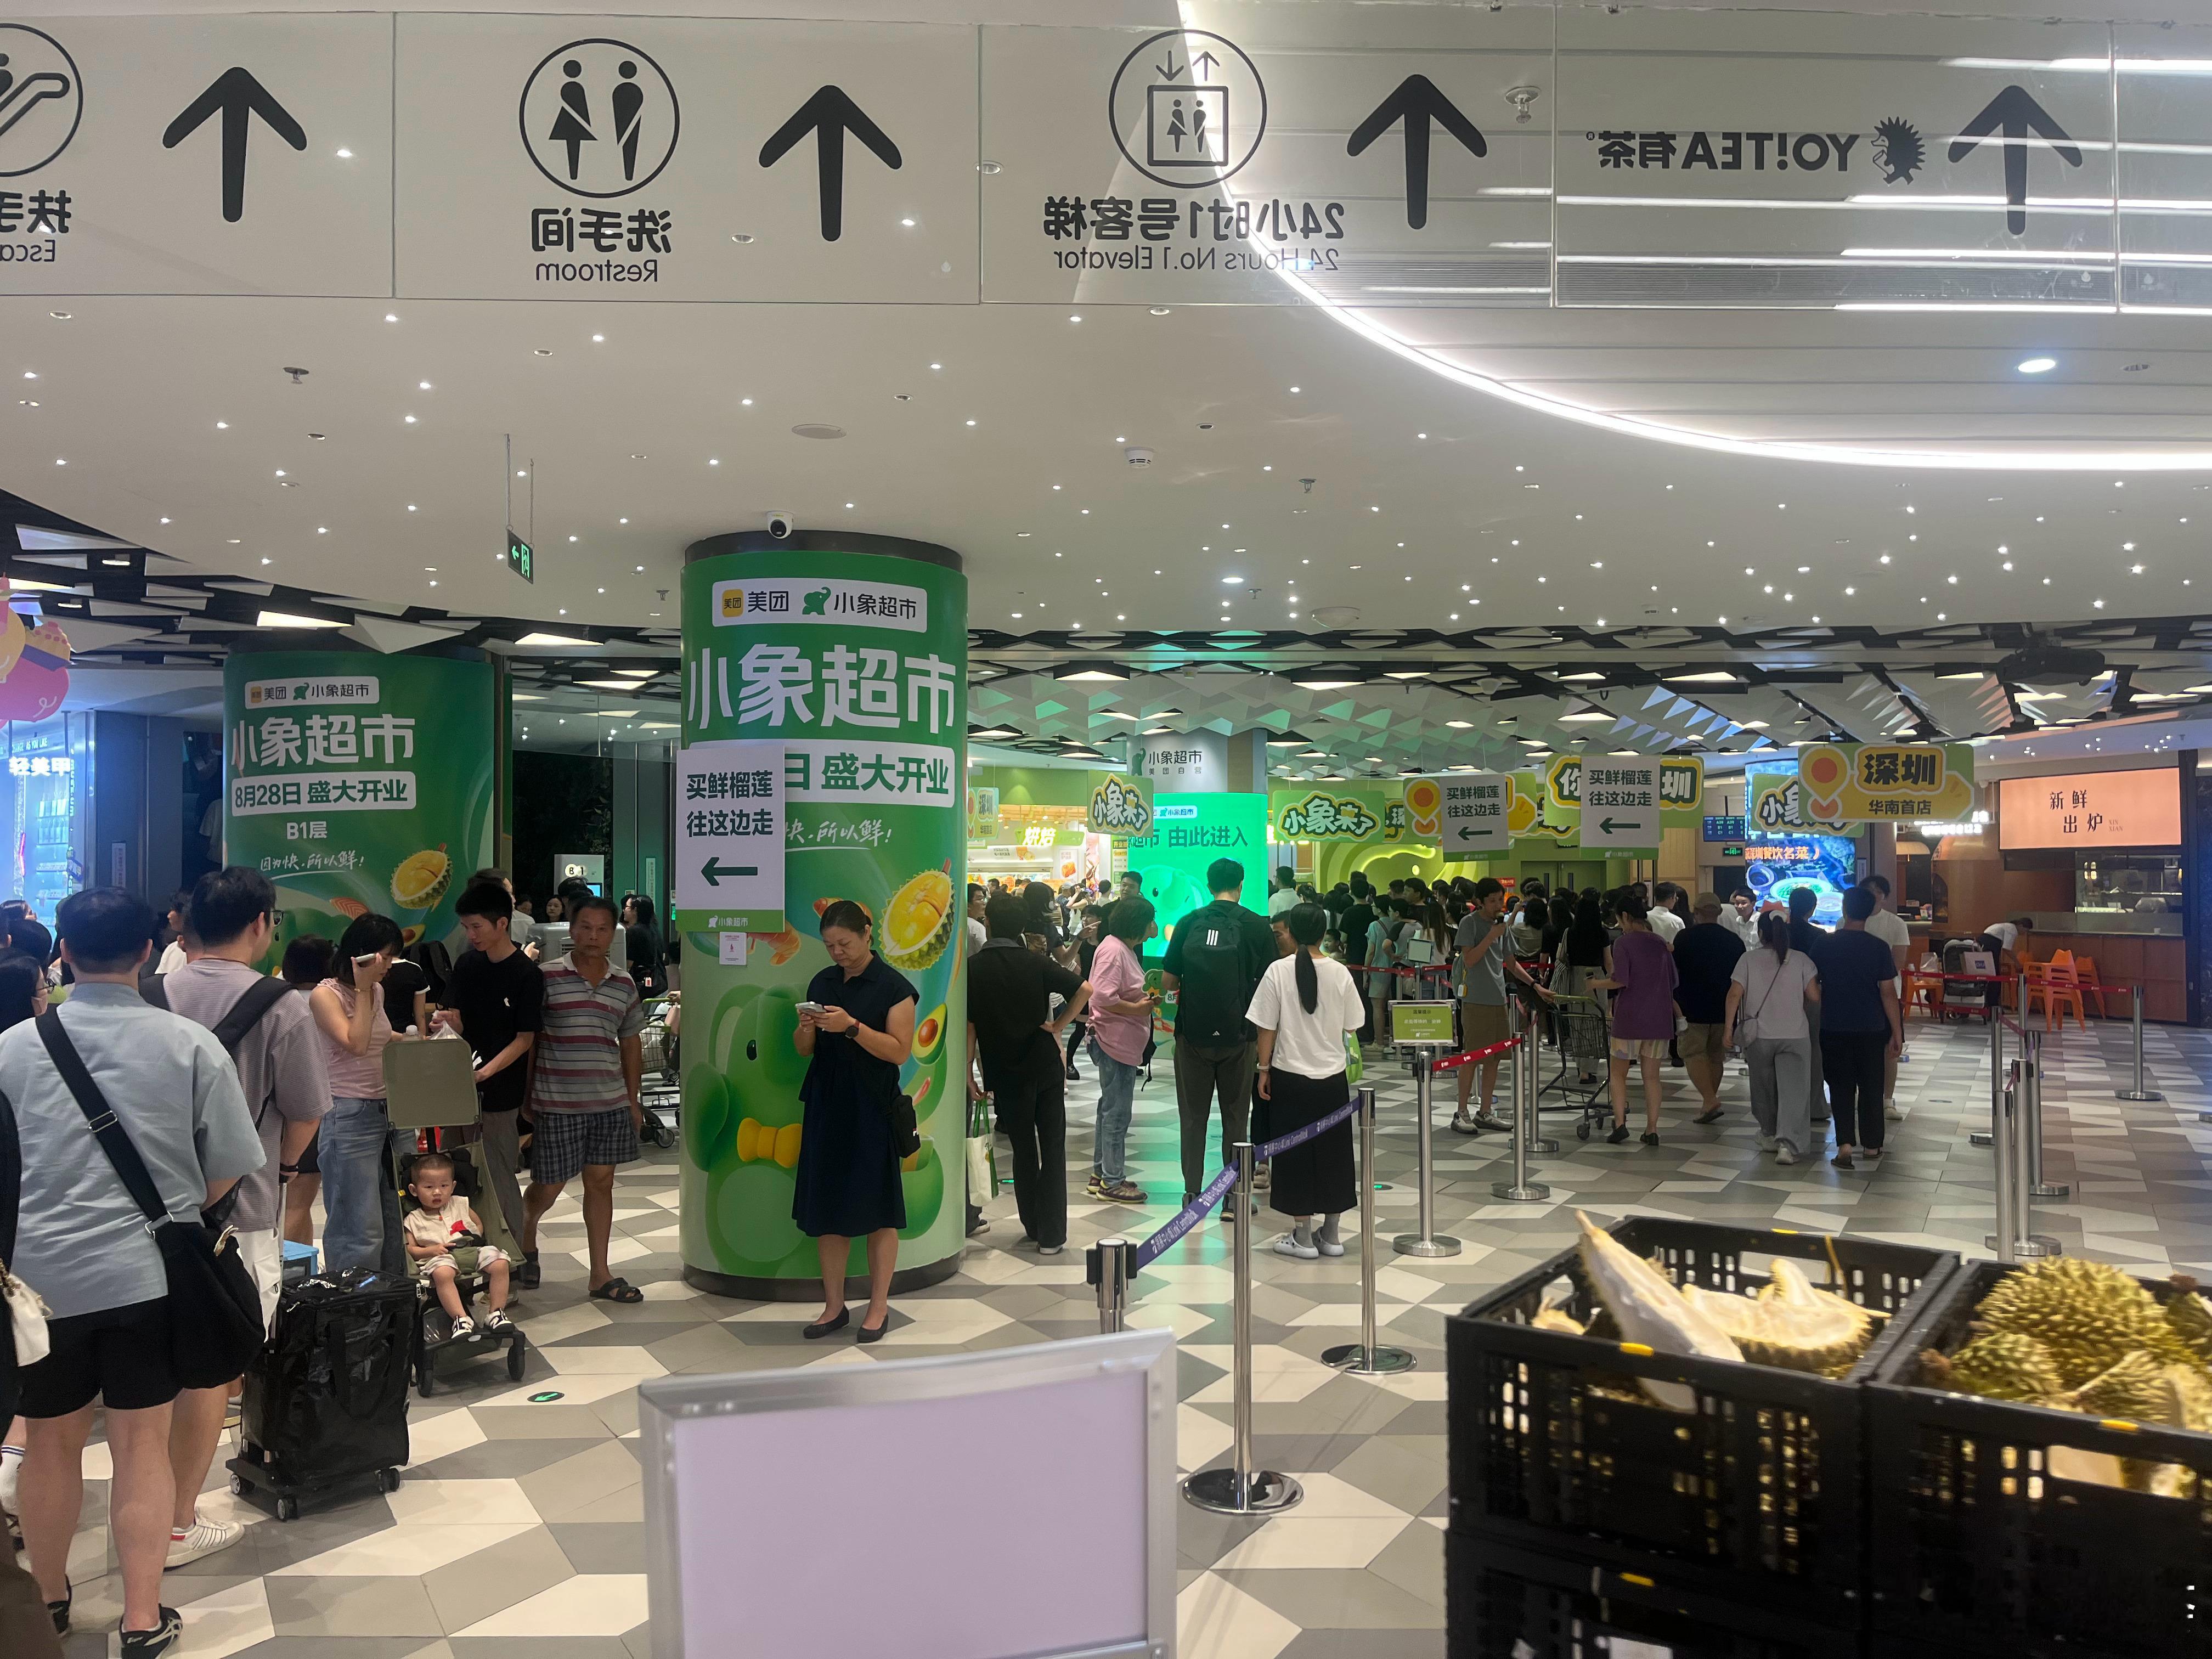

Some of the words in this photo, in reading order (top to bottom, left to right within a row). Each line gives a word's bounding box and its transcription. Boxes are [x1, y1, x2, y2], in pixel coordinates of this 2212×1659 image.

[747, 590, 789, 613] 美团
[833, 591, 917, 620] 小象超市
[264, 686, 286, 701] 美团
[311, 682, 370, 698] 小象超市
[687, 643, 956, 734] 小象超市
[40, 737, 48, 748] LIKE
[231, 713, 416, 770] 小象超市
[9, 756, 71, 777] 轻美甲
[1148, 750, 1203, 765] 小象超市
[821, 752, 950, 794] 盛大开业
[1588, 769, 1652, 786] 买鲜榴莲
[1864, 752, 1936, 786] 深圳
[235, 781, 301, 808] 8月28日
[307, 778, 408, 804] 盛大开业
[686, 770, 773, 800] 买鲜榴莲
[1446, 785, 1500, 801] 买鲜榴莲
[1094, 782, 1147, 829] 小象来了
[1588, 790, 1652, 807] 往这边走
[1868, 799, 1932, 815] 华南首店
[2049, 789, 2087, 810] 新鲜
[1284, 795, 1373, 834] 小象来了
[1447, 803, 1501, 819] 往这边走
[286, 821, 328, 839] B1层
[686, 808, 774, 838] 往这边走
[2063, 812, 2103, 833] 出炉
[1022, 826, 1057, 847] 烘焙
[1169, 826, 1248, 848] 由此进入
[718, 917, 748, 927] 小象超市
